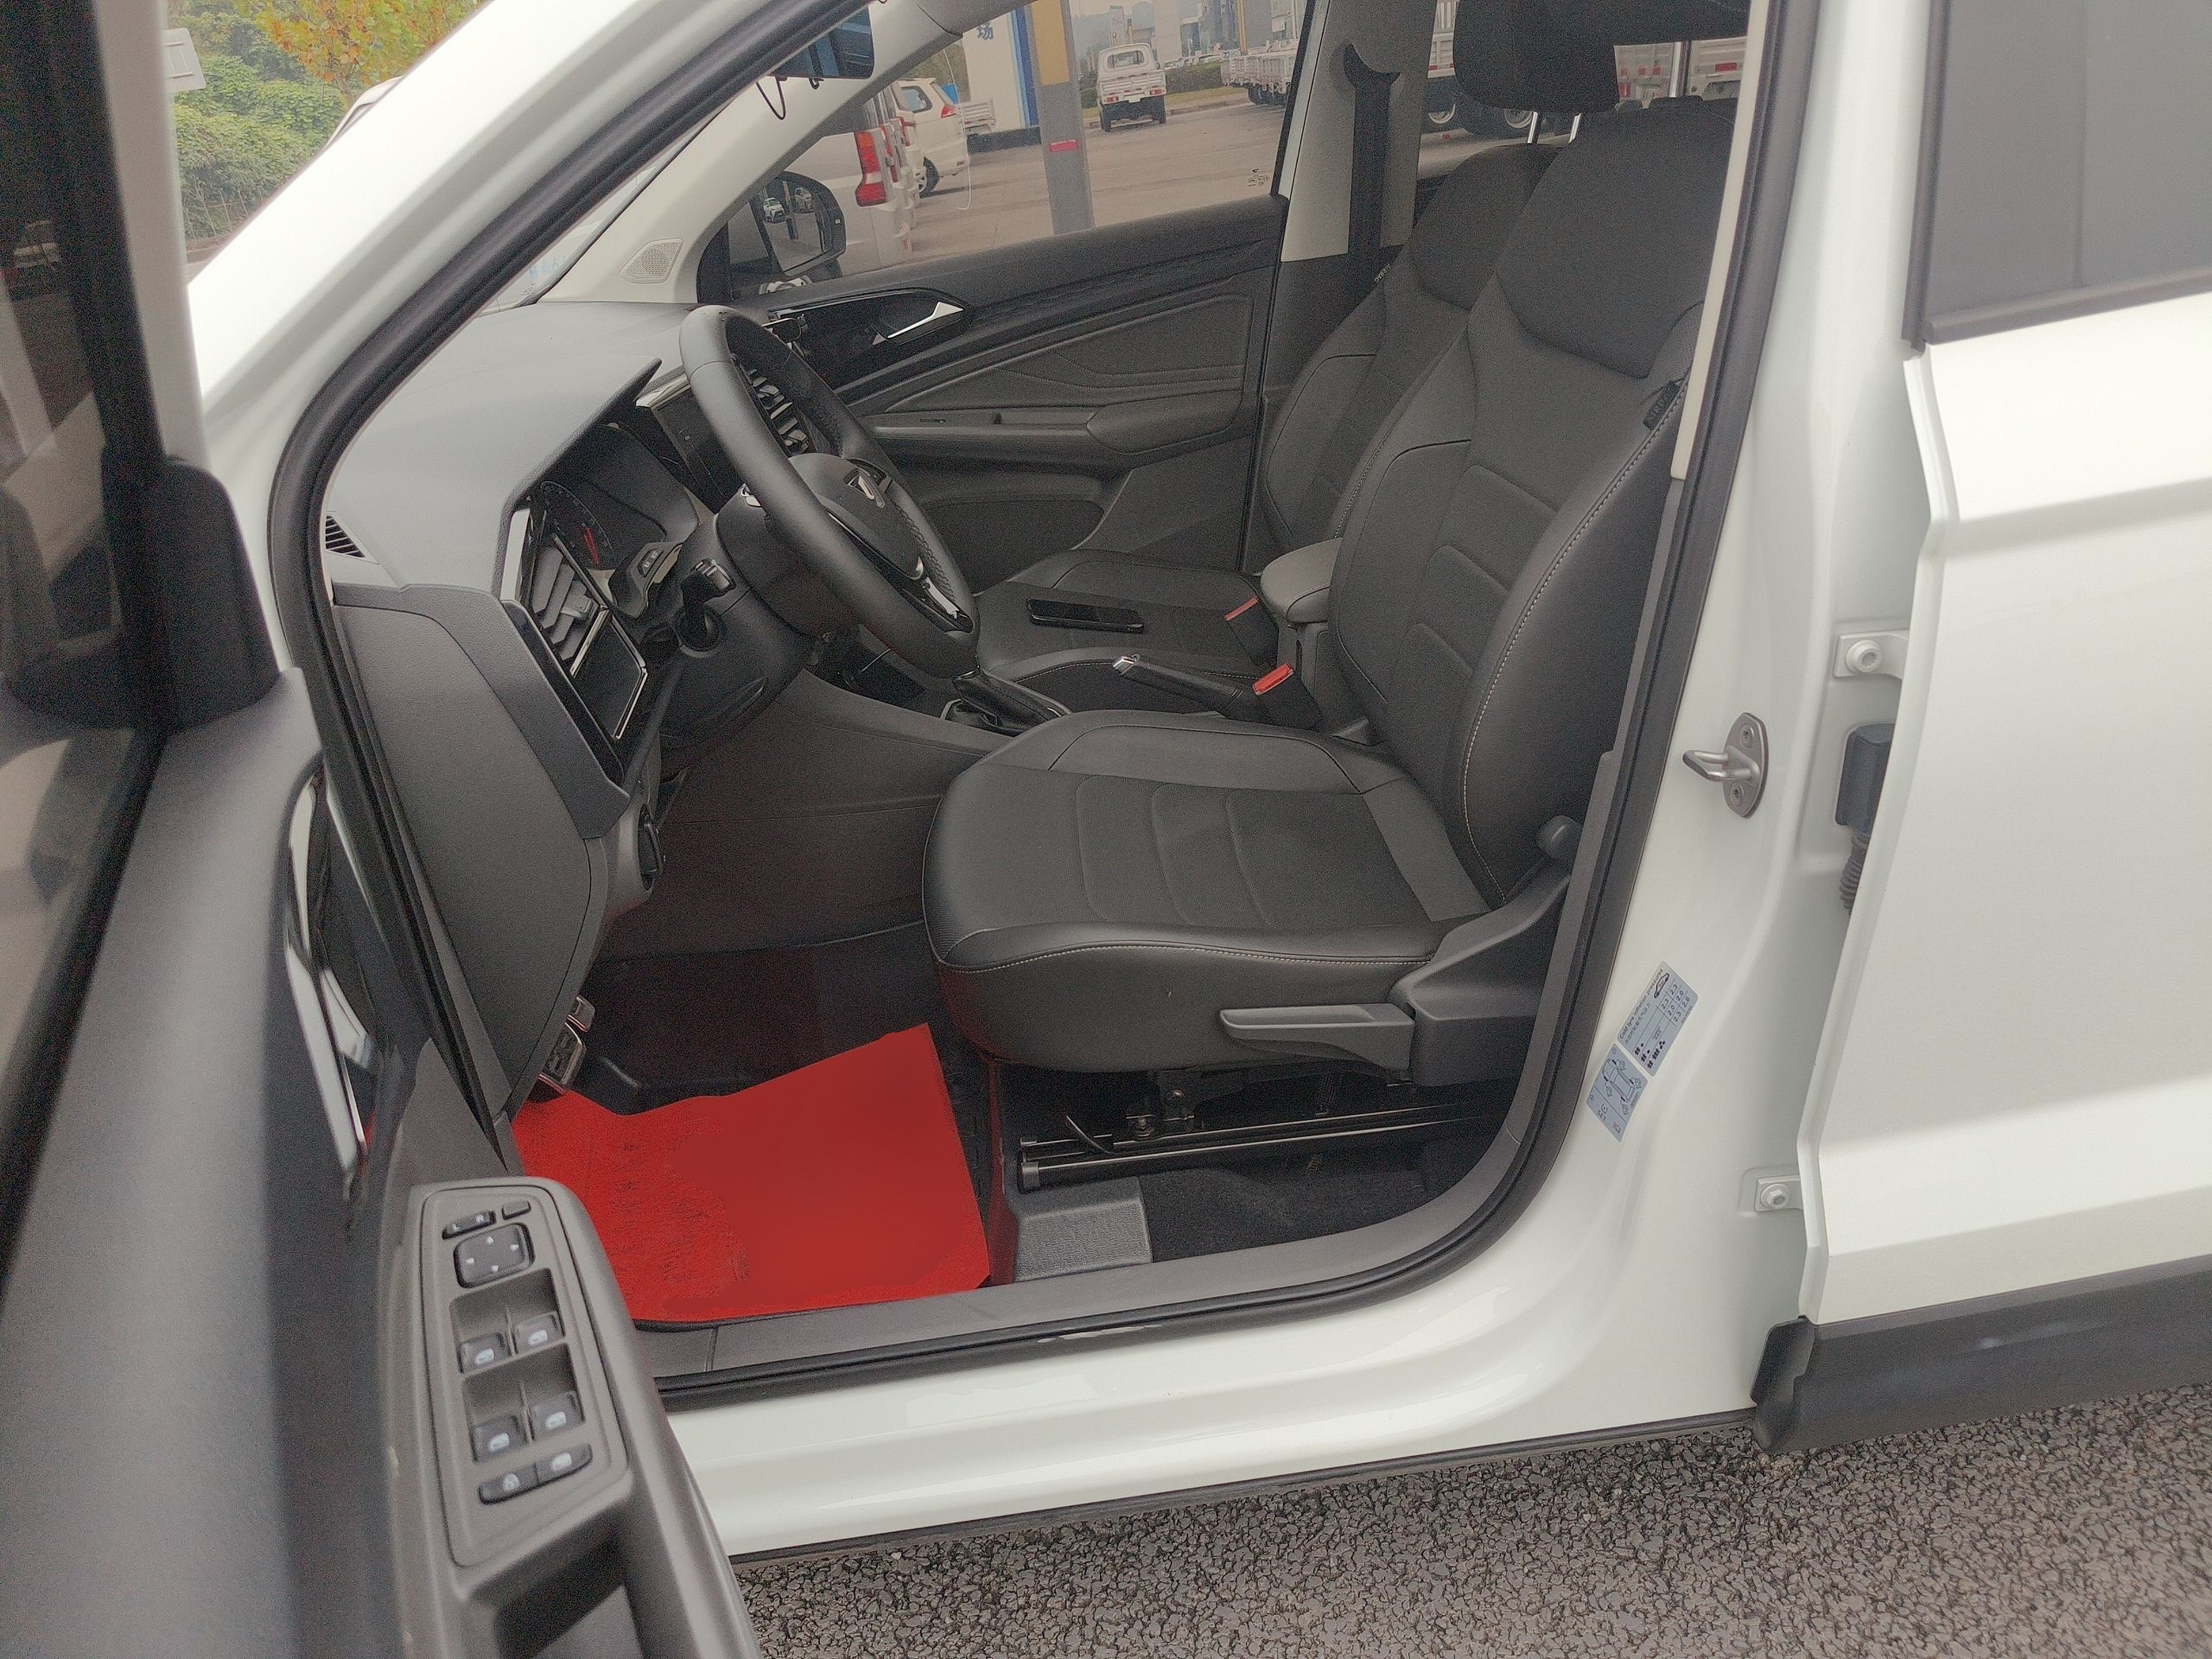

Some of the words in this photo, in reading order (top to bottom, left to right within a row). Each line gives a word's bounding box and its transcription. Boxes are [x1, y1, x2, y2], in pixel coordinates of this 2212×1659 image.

[1374, 263, 1391, 283] AIRBAG
[1661, 998, 1669, 1009] 2.3
[1669, 984, 1678, 995] 2.3
[1667, 1005, 1676, 1016] 2.0
[1676, 990, 1684, 1001] 2.0
[1673, 1011, 1681, 1022] 2.3
[1619, 1026, 1628, 1039] Cold
[452, 1223, 460, 1232] L
[476, 1214, 484, 1222] R
